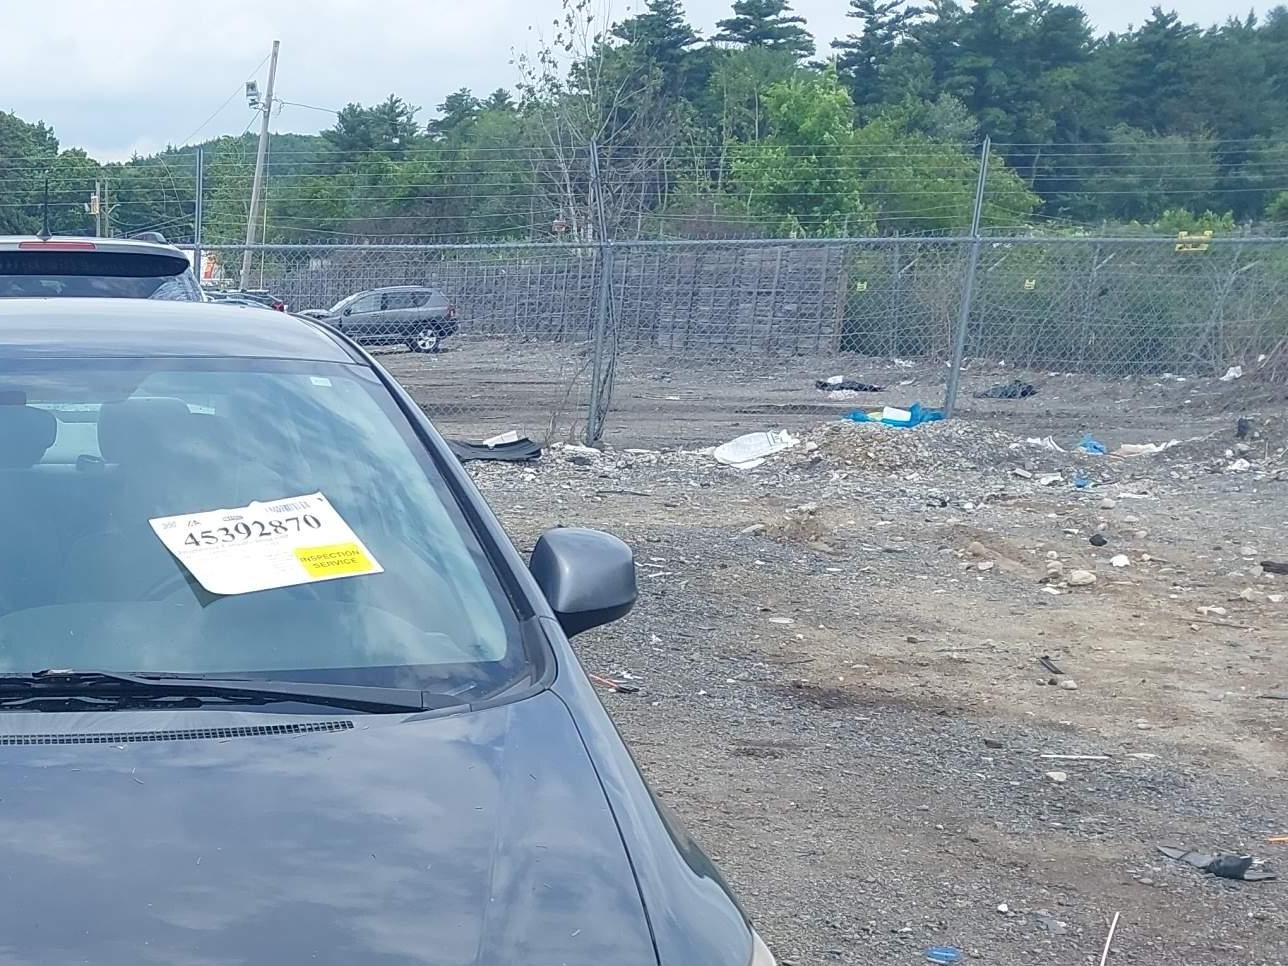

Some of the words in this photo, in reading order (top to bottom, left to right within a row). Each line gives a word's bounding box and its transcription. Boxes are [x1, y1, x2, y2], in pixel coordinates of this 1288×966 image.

[183, 513, 322, 547] 45392870
[299, 550, 360, 562] INSPECTION
[312, 558, 359, 569] SERVICE
